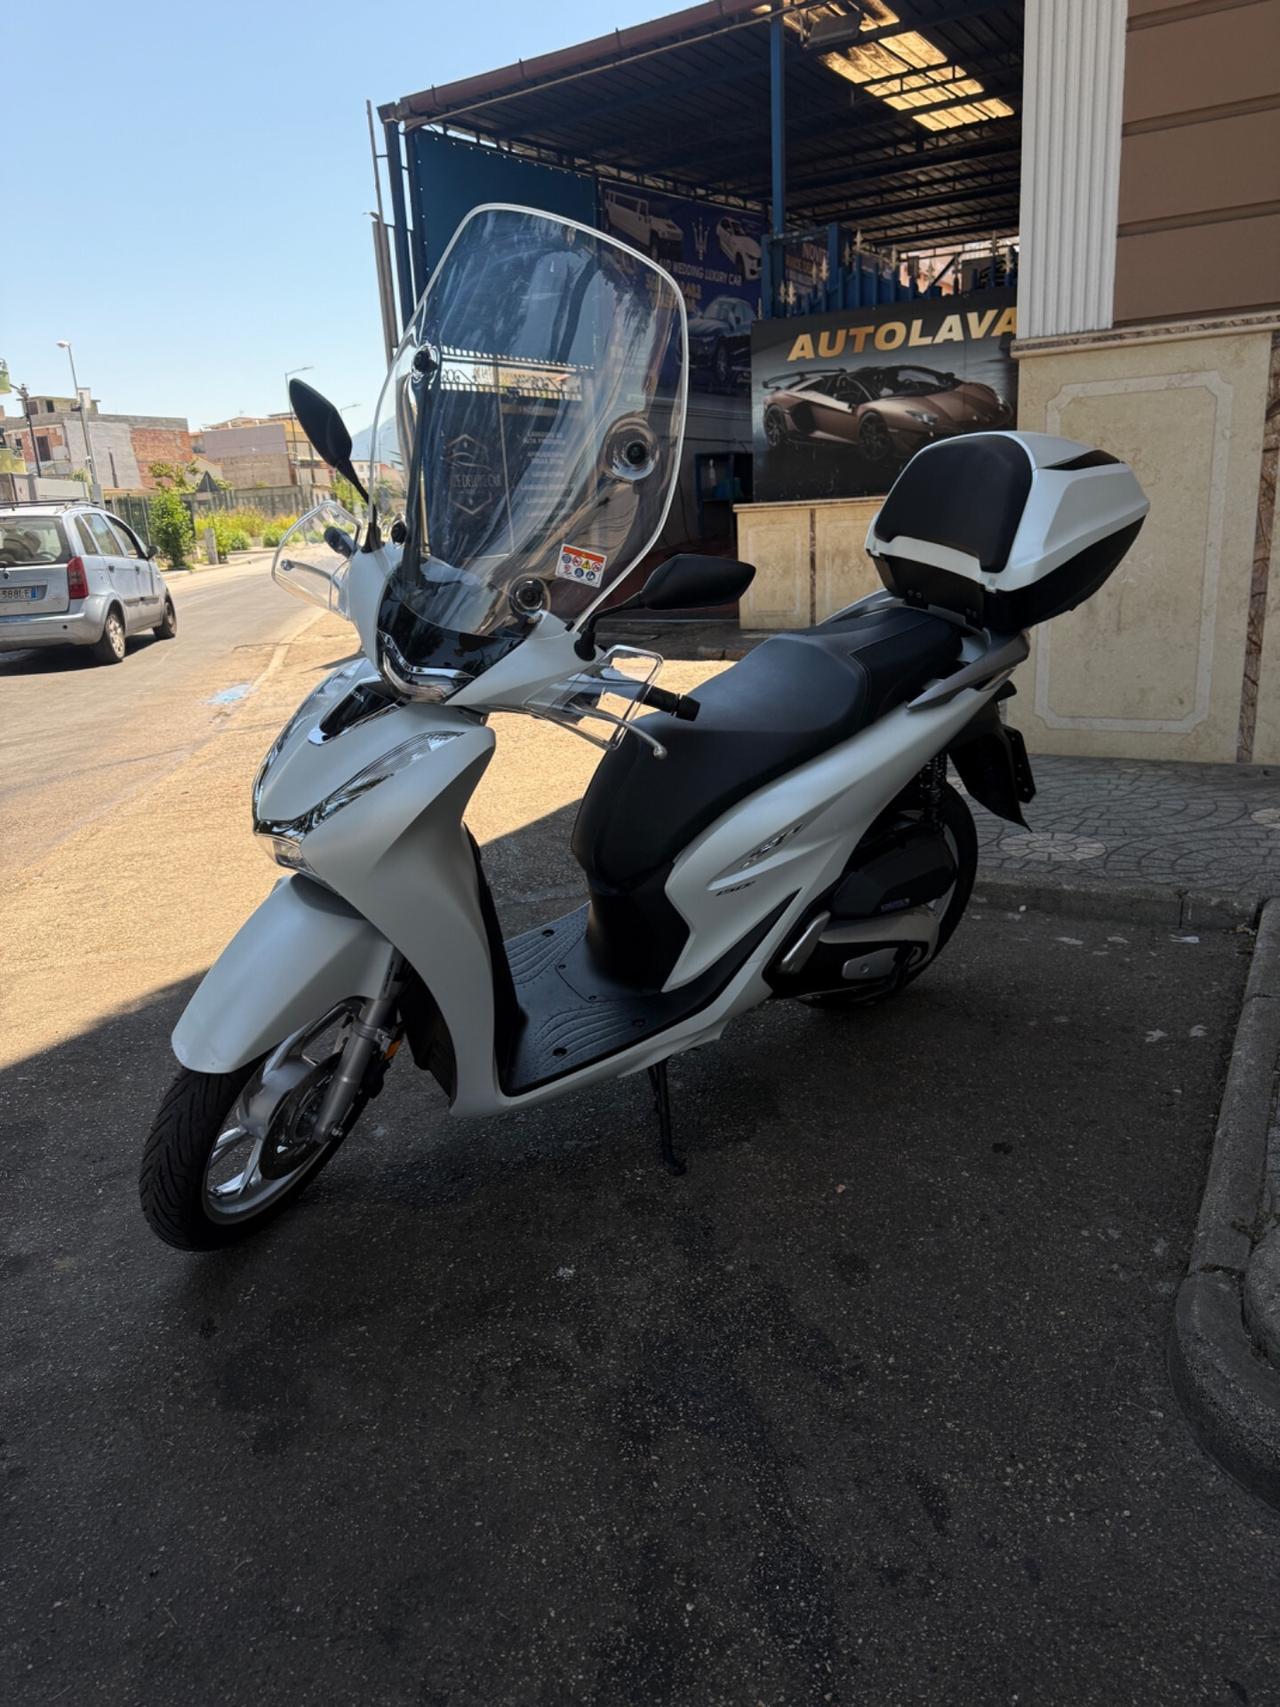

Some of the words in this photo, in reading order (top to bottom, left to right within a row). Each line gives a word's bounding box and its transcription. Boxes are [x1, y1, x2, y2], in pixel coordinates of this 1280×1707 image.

[673, 261, 704, 279] WEDDING
[704, 268, 728, 283] LUXURY
[728, 272, 742, 286] CAR
[787, 306, 1017, 362] AUTOLAVA
